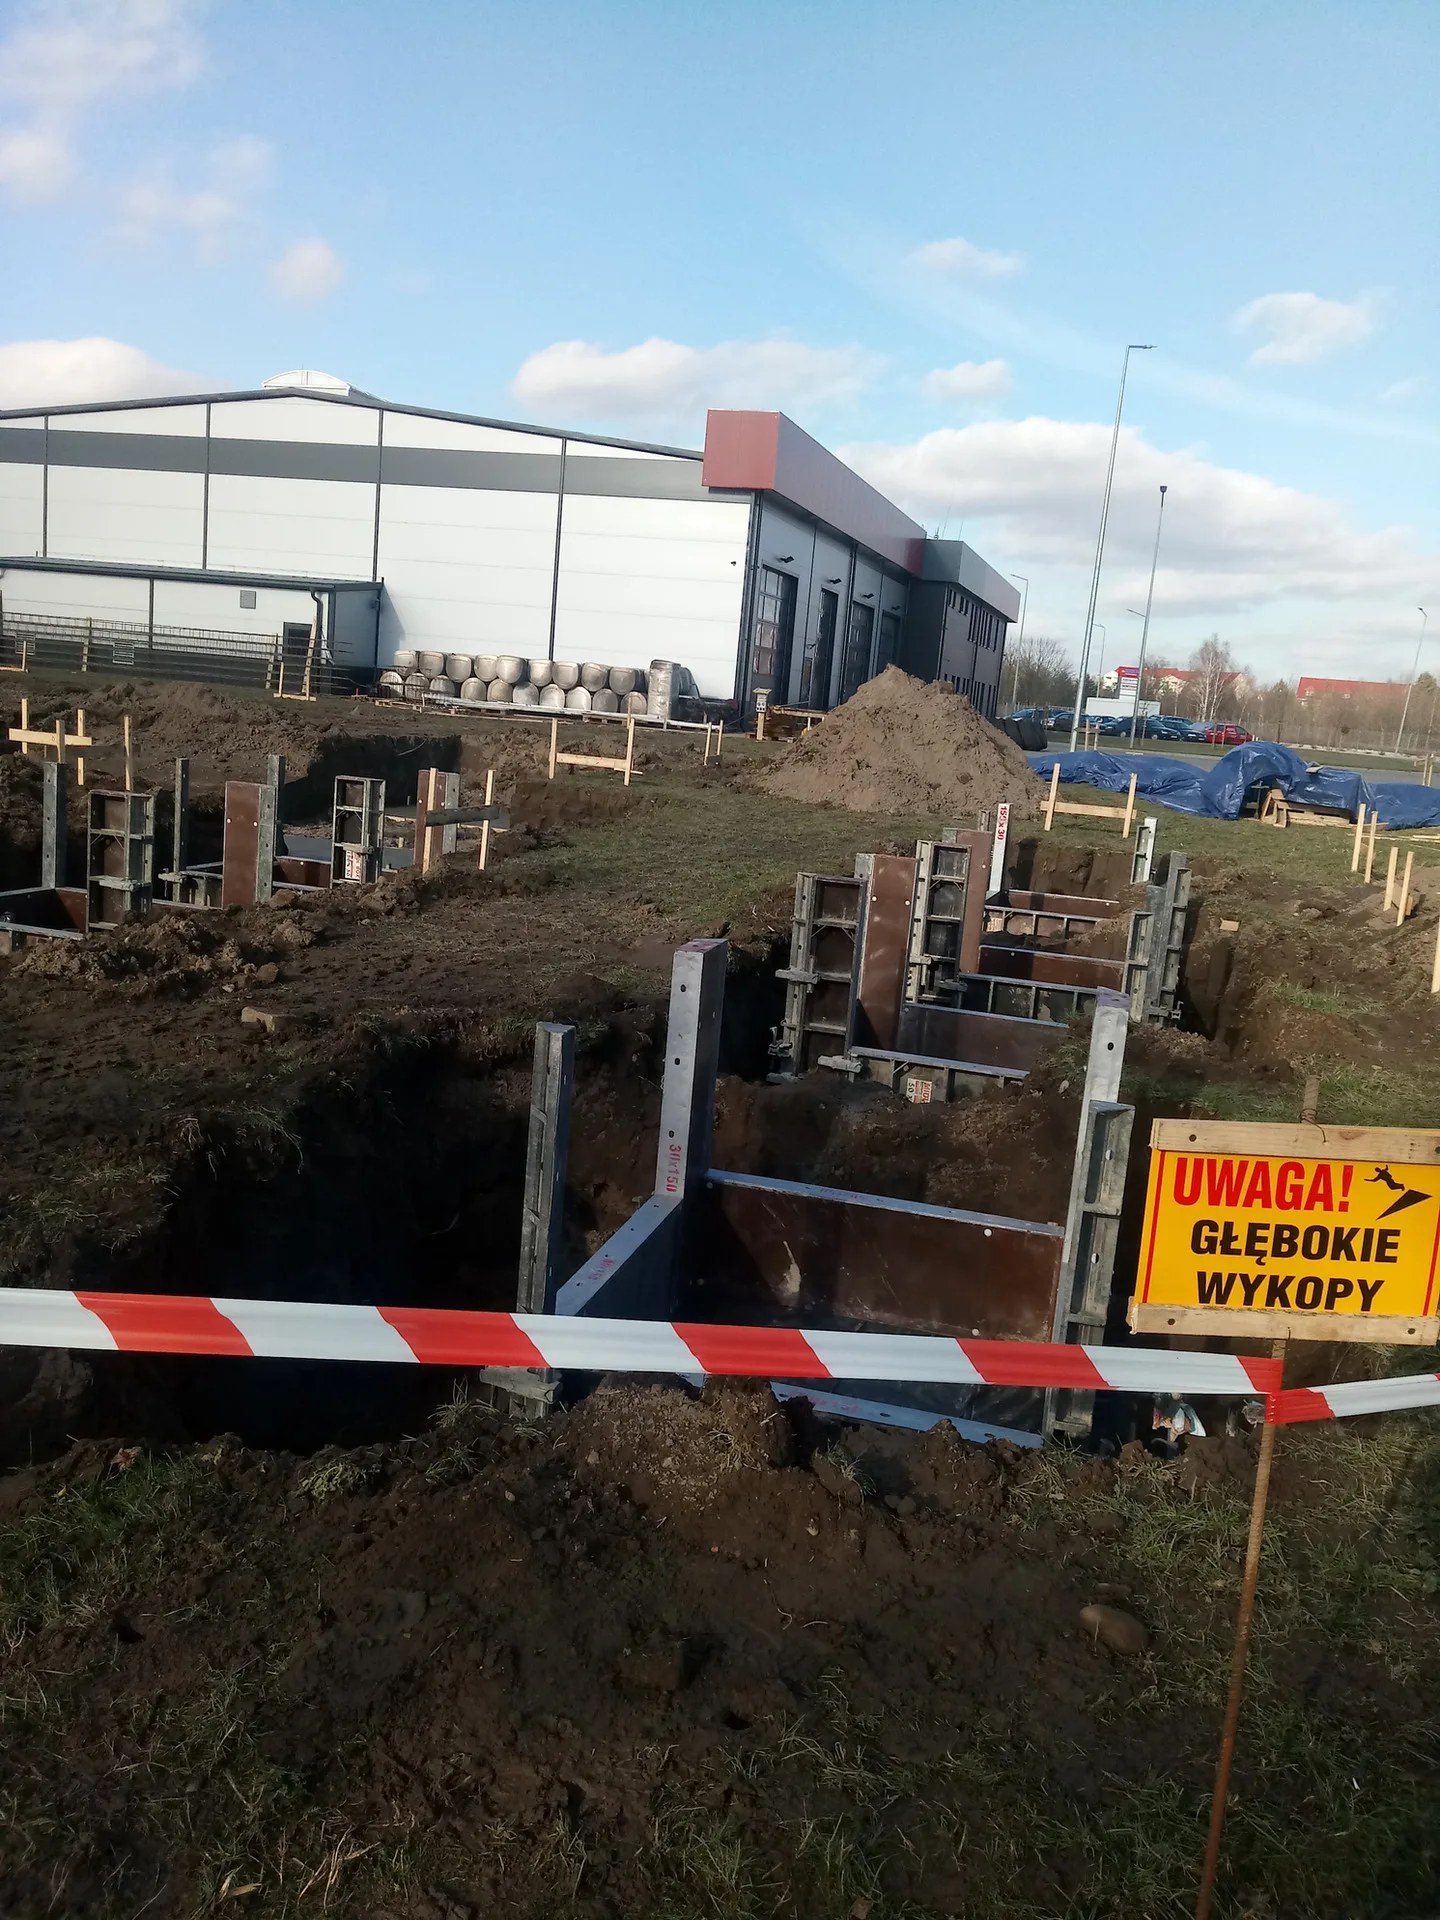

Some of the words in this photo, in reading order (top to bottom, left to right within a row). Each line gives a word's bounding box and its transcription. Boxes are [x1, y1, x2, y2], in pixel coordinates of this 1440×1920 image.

[1173, 1157, 1354, 1212] UWAGA!
[1190, 1219, 1401, 1266] GŁĘBOKIE
[1197, 1271, 1385, 1312] WYKOPY
